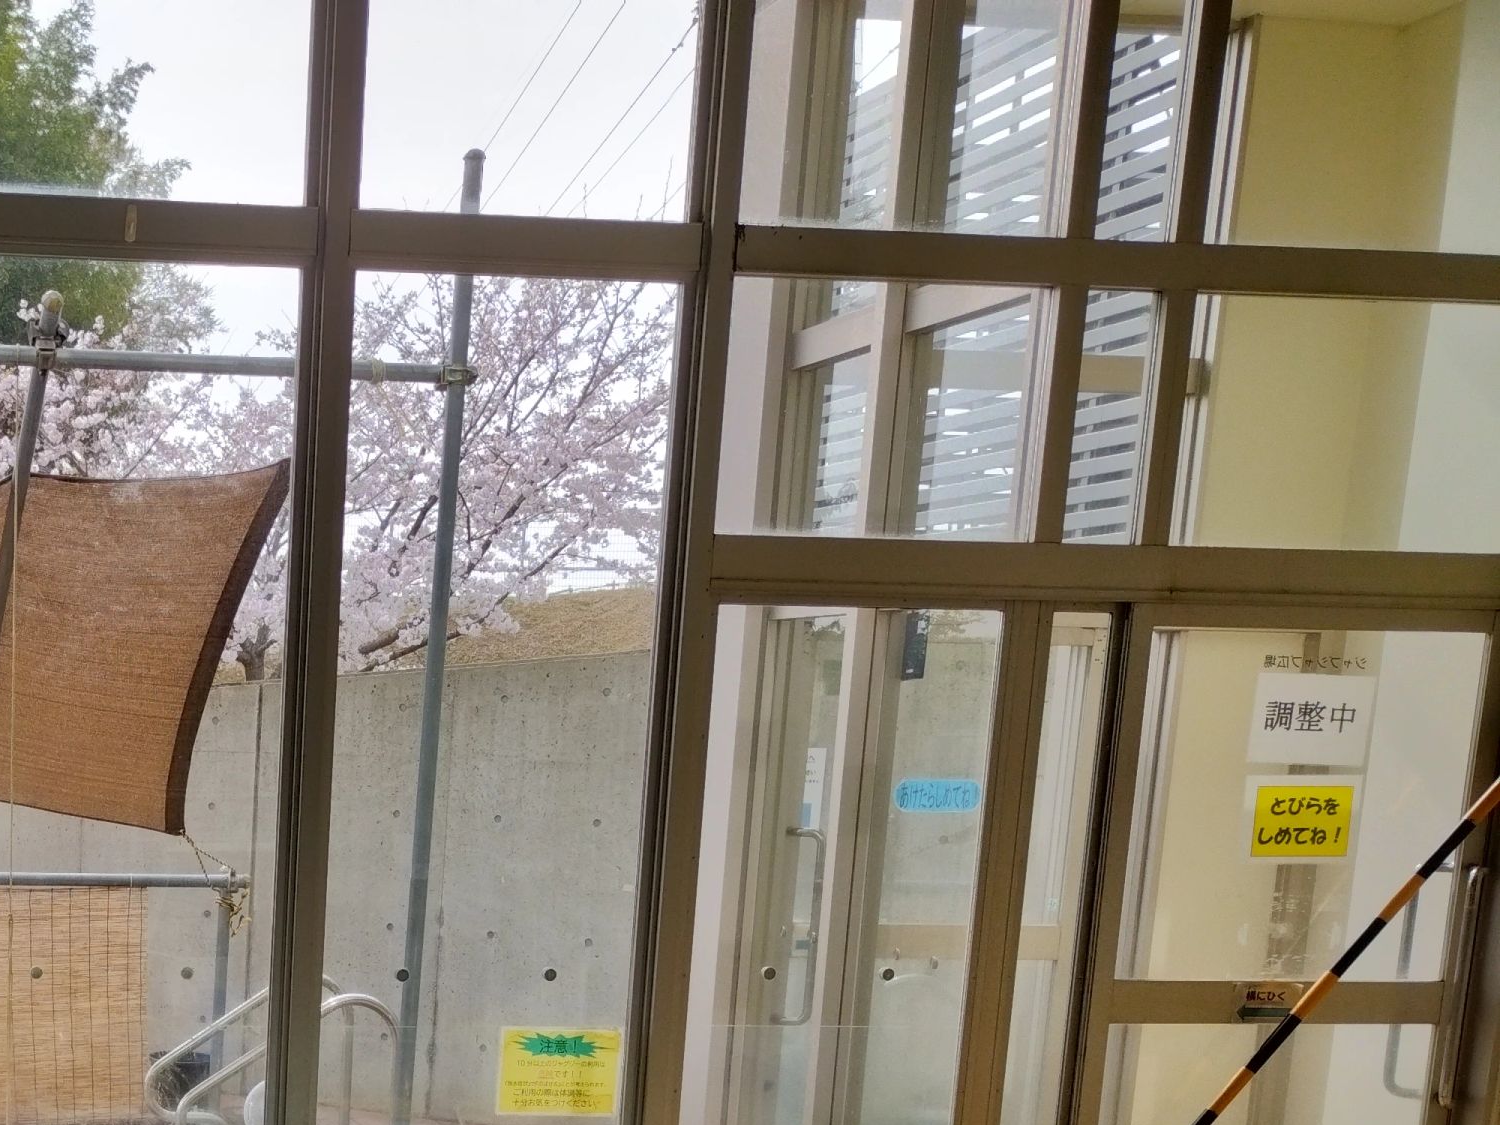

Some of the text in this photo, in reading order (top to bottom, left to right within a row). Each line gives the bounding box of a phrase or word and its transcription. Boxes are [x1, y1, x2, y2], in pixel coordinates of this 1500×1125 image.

[1264, 700, 1357, 733] 調整中
[1270, 797, 1340, 816] とびらを
[1257, 826, 1342, 845] しめてね！
